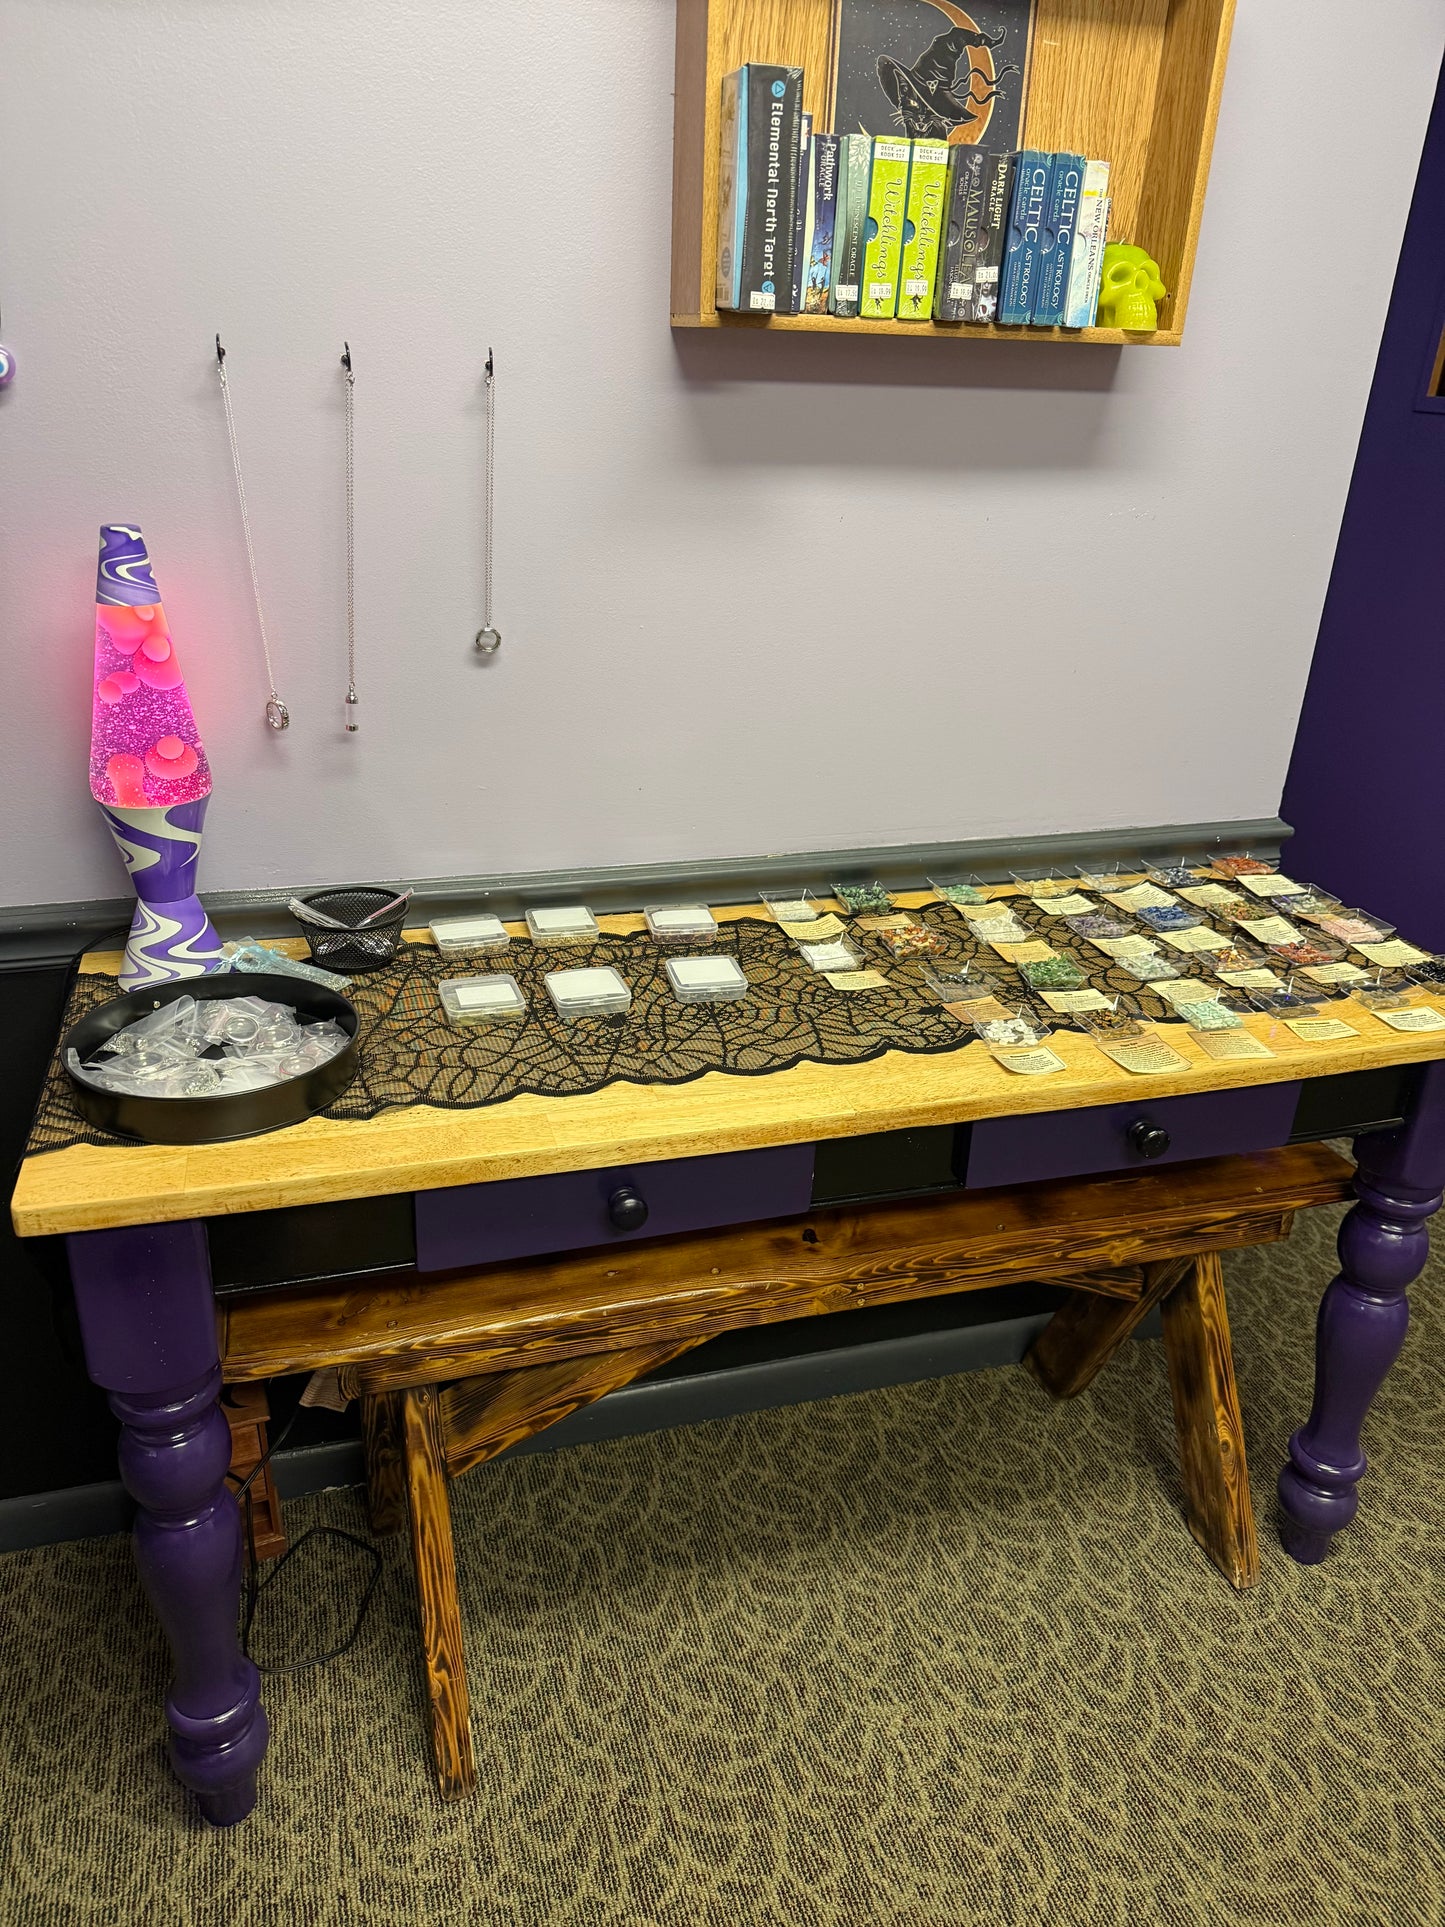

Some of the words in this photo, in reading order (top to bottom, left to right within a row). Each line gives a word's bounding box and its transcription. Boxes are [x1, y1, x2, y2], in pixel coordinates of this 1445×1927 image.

[768, 102, 784, 184] Elemental
[823, 143, 837, 201] Pathwork
[989, 180, 998, 212] ORACLE
[997, 163, 1008, 195] DARK
[1024, 168, 1046, 243] CELTIC
[1057, 171, 1079, 245] CELTIC
[872, 178, 902, 278] Witchlings
[909, 181, 941, 280] Witchlings
[959, 189, 984, 284] MAUSOLEA
[991, 197, 1004, 230] LIGHT
[1094, 199, 1104, 222] NEW
[763, 236, 776, 277] Tarot
[848, 247, 857, 276] ORACLE
[1019, 247, 1033, 308] ASTROLOGY
[1087, 225, 1099, 271] ORLEANS
[1051, 249, 1065, 309] ASTROLOGY
